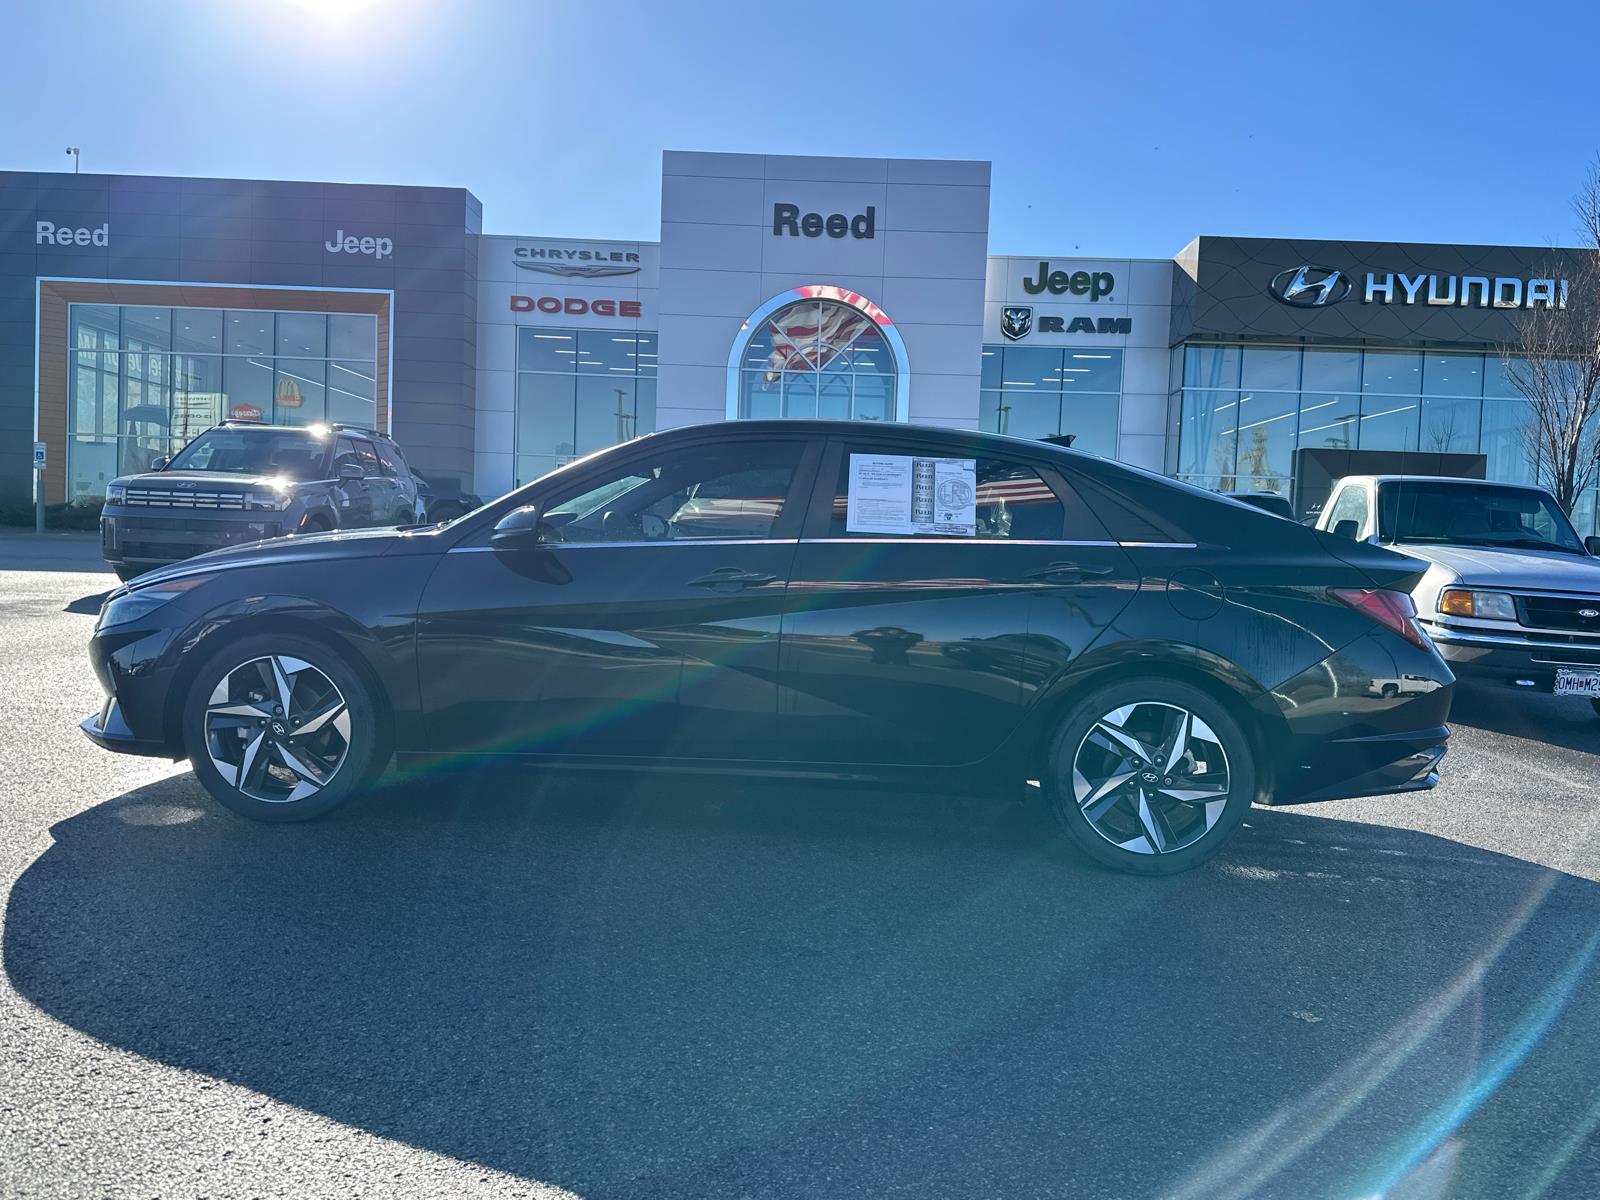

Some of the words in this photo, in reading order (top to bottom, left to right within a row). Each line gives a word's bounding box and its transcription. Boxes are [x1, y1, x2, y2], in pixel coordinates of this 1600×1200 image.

[36, 221, 108, 247] Reed
[773, 203, 875, 240] Reed
[325, 230, 393, 259] Jeep
[514, 247, 640, 263] CHRYSLER
[1023, 262, 1114, 302] Jeep
[1364, 271, 1568, 310] HYUNDAI
[510, 295, 642, 318] DODGE
[1039, 315, 1132, 334] RAM
